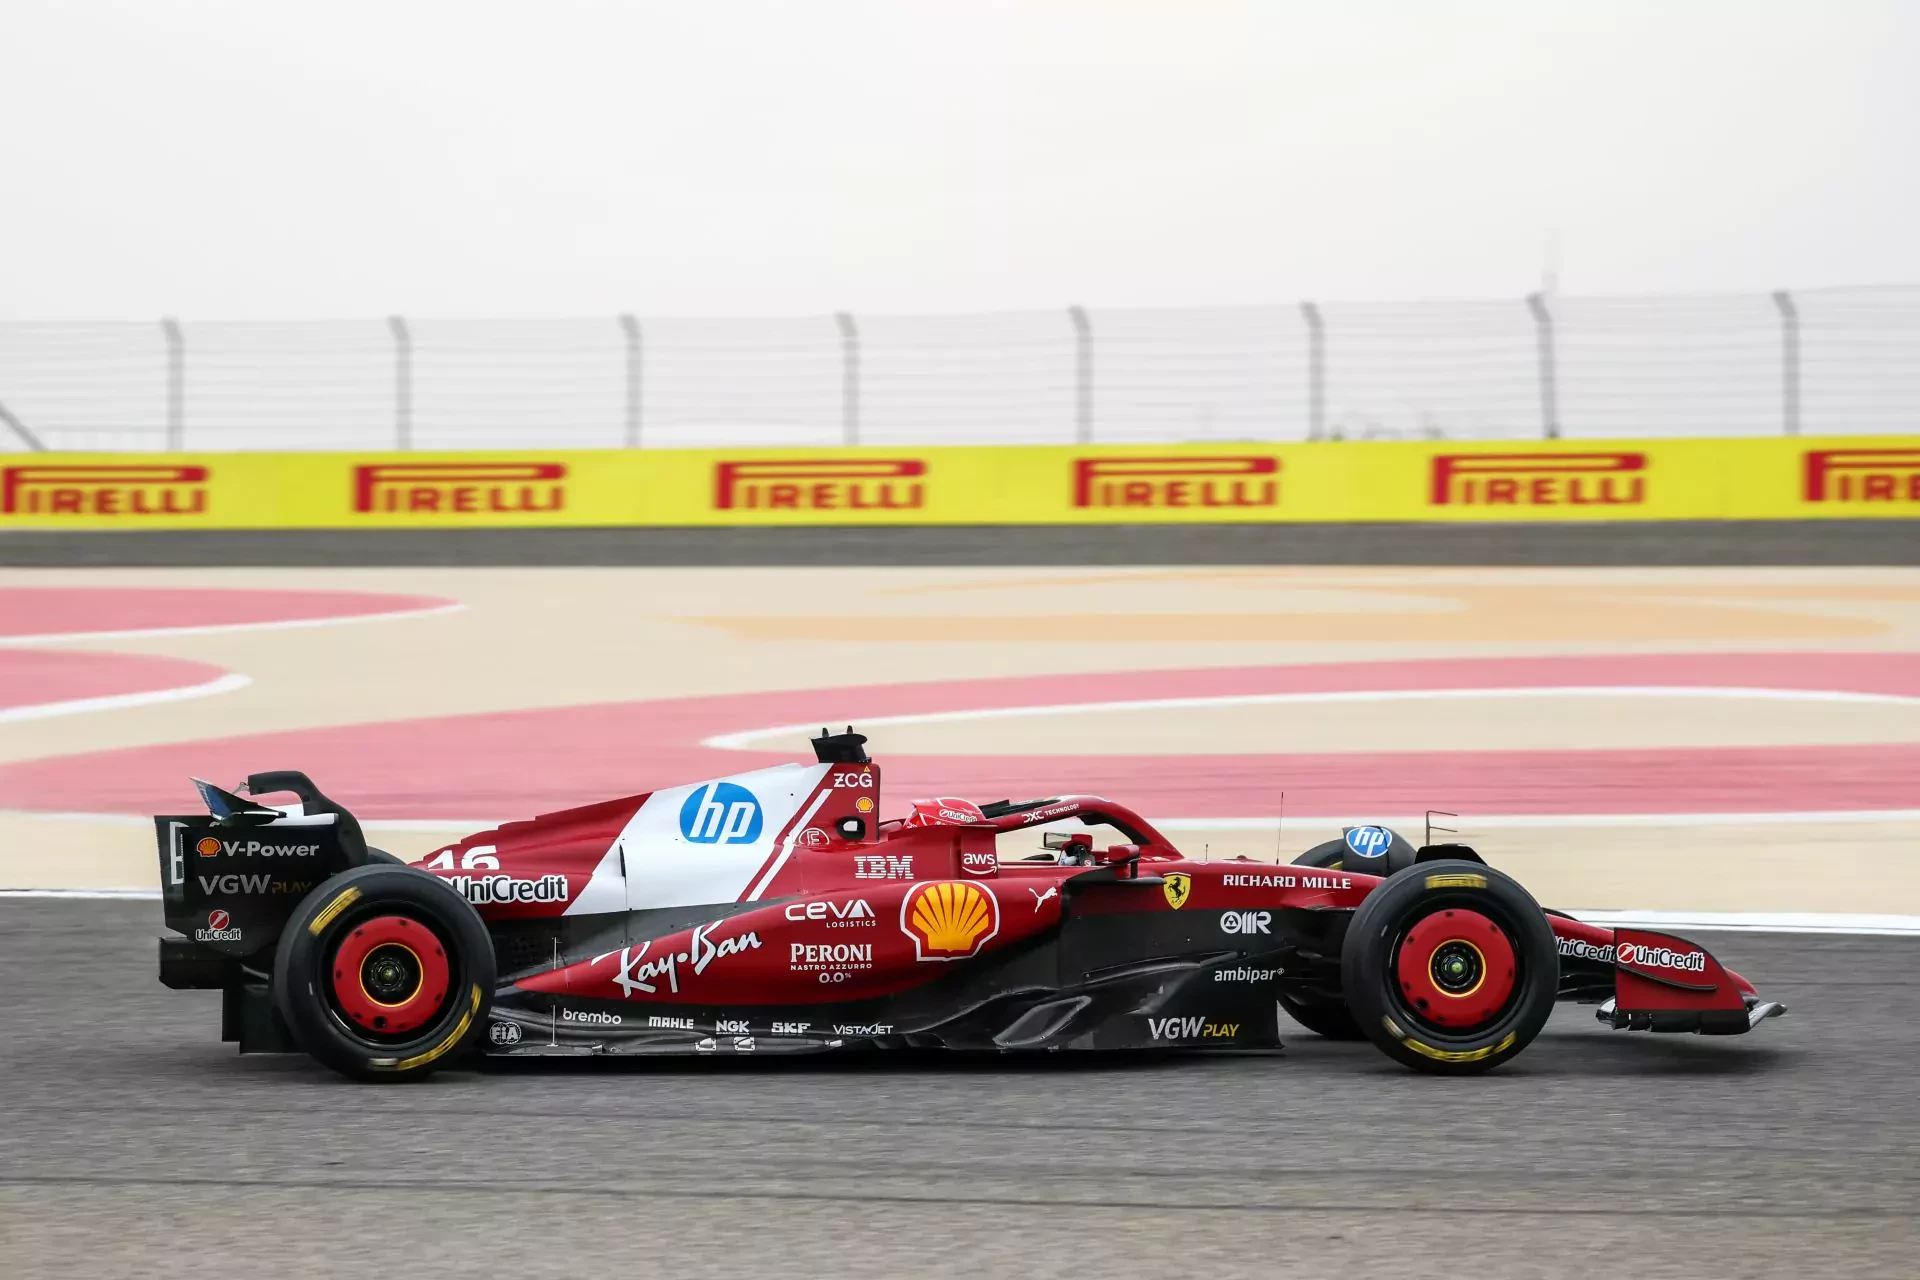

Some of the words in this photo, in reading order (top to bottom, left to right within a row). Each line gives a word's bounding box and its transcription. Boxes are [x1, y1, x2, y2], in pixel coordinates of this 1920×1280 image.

[2, 465, 210, 514] PIRELLI
[353, 463, 566, 513] PIRELLI
[715, 460, 926, 510] PIRELLI
[1071, 457, 1280, 508] PIRELLI
[1431, 453, 1645, 505] PIRELLI
[687, 783, 758, 844] hp
[1021, 810, 1045, 823] DXC
[1044, 803, 1080, 816] TECHNOLOGY
[222, 840, 320, 857] V-Power
[1351, 827, 1386, 857] hp
[427, 845, 500, 870] 16
[854, 855, 914, 879] IBM
[963, 853, 996, 865] aws
[198, 874, 272, 895] VGW
[271, 881, 312, 895] PLAY
[1223, 874, 1296, 888] RICHARD
[1302, 877, 1352, 889] MILLE
[196, 929, 241, 940] UniCredit
[826, 920, 876, 928] LOGISTICS
[790, 943, 872, 963] PERONI
[1635, 946, 1704, 970] UniCredit
[563, 1008, 622, 1024] brembo
[649, 1016, 694, 1030] MAHLE
[715, 1020, 750, 1033] NGK
[771, 1022, 811, 1033] SKF
[1148, 1016, 1206, 1040] VGW
[1203, 1023, 1240, 1037] PLAY
